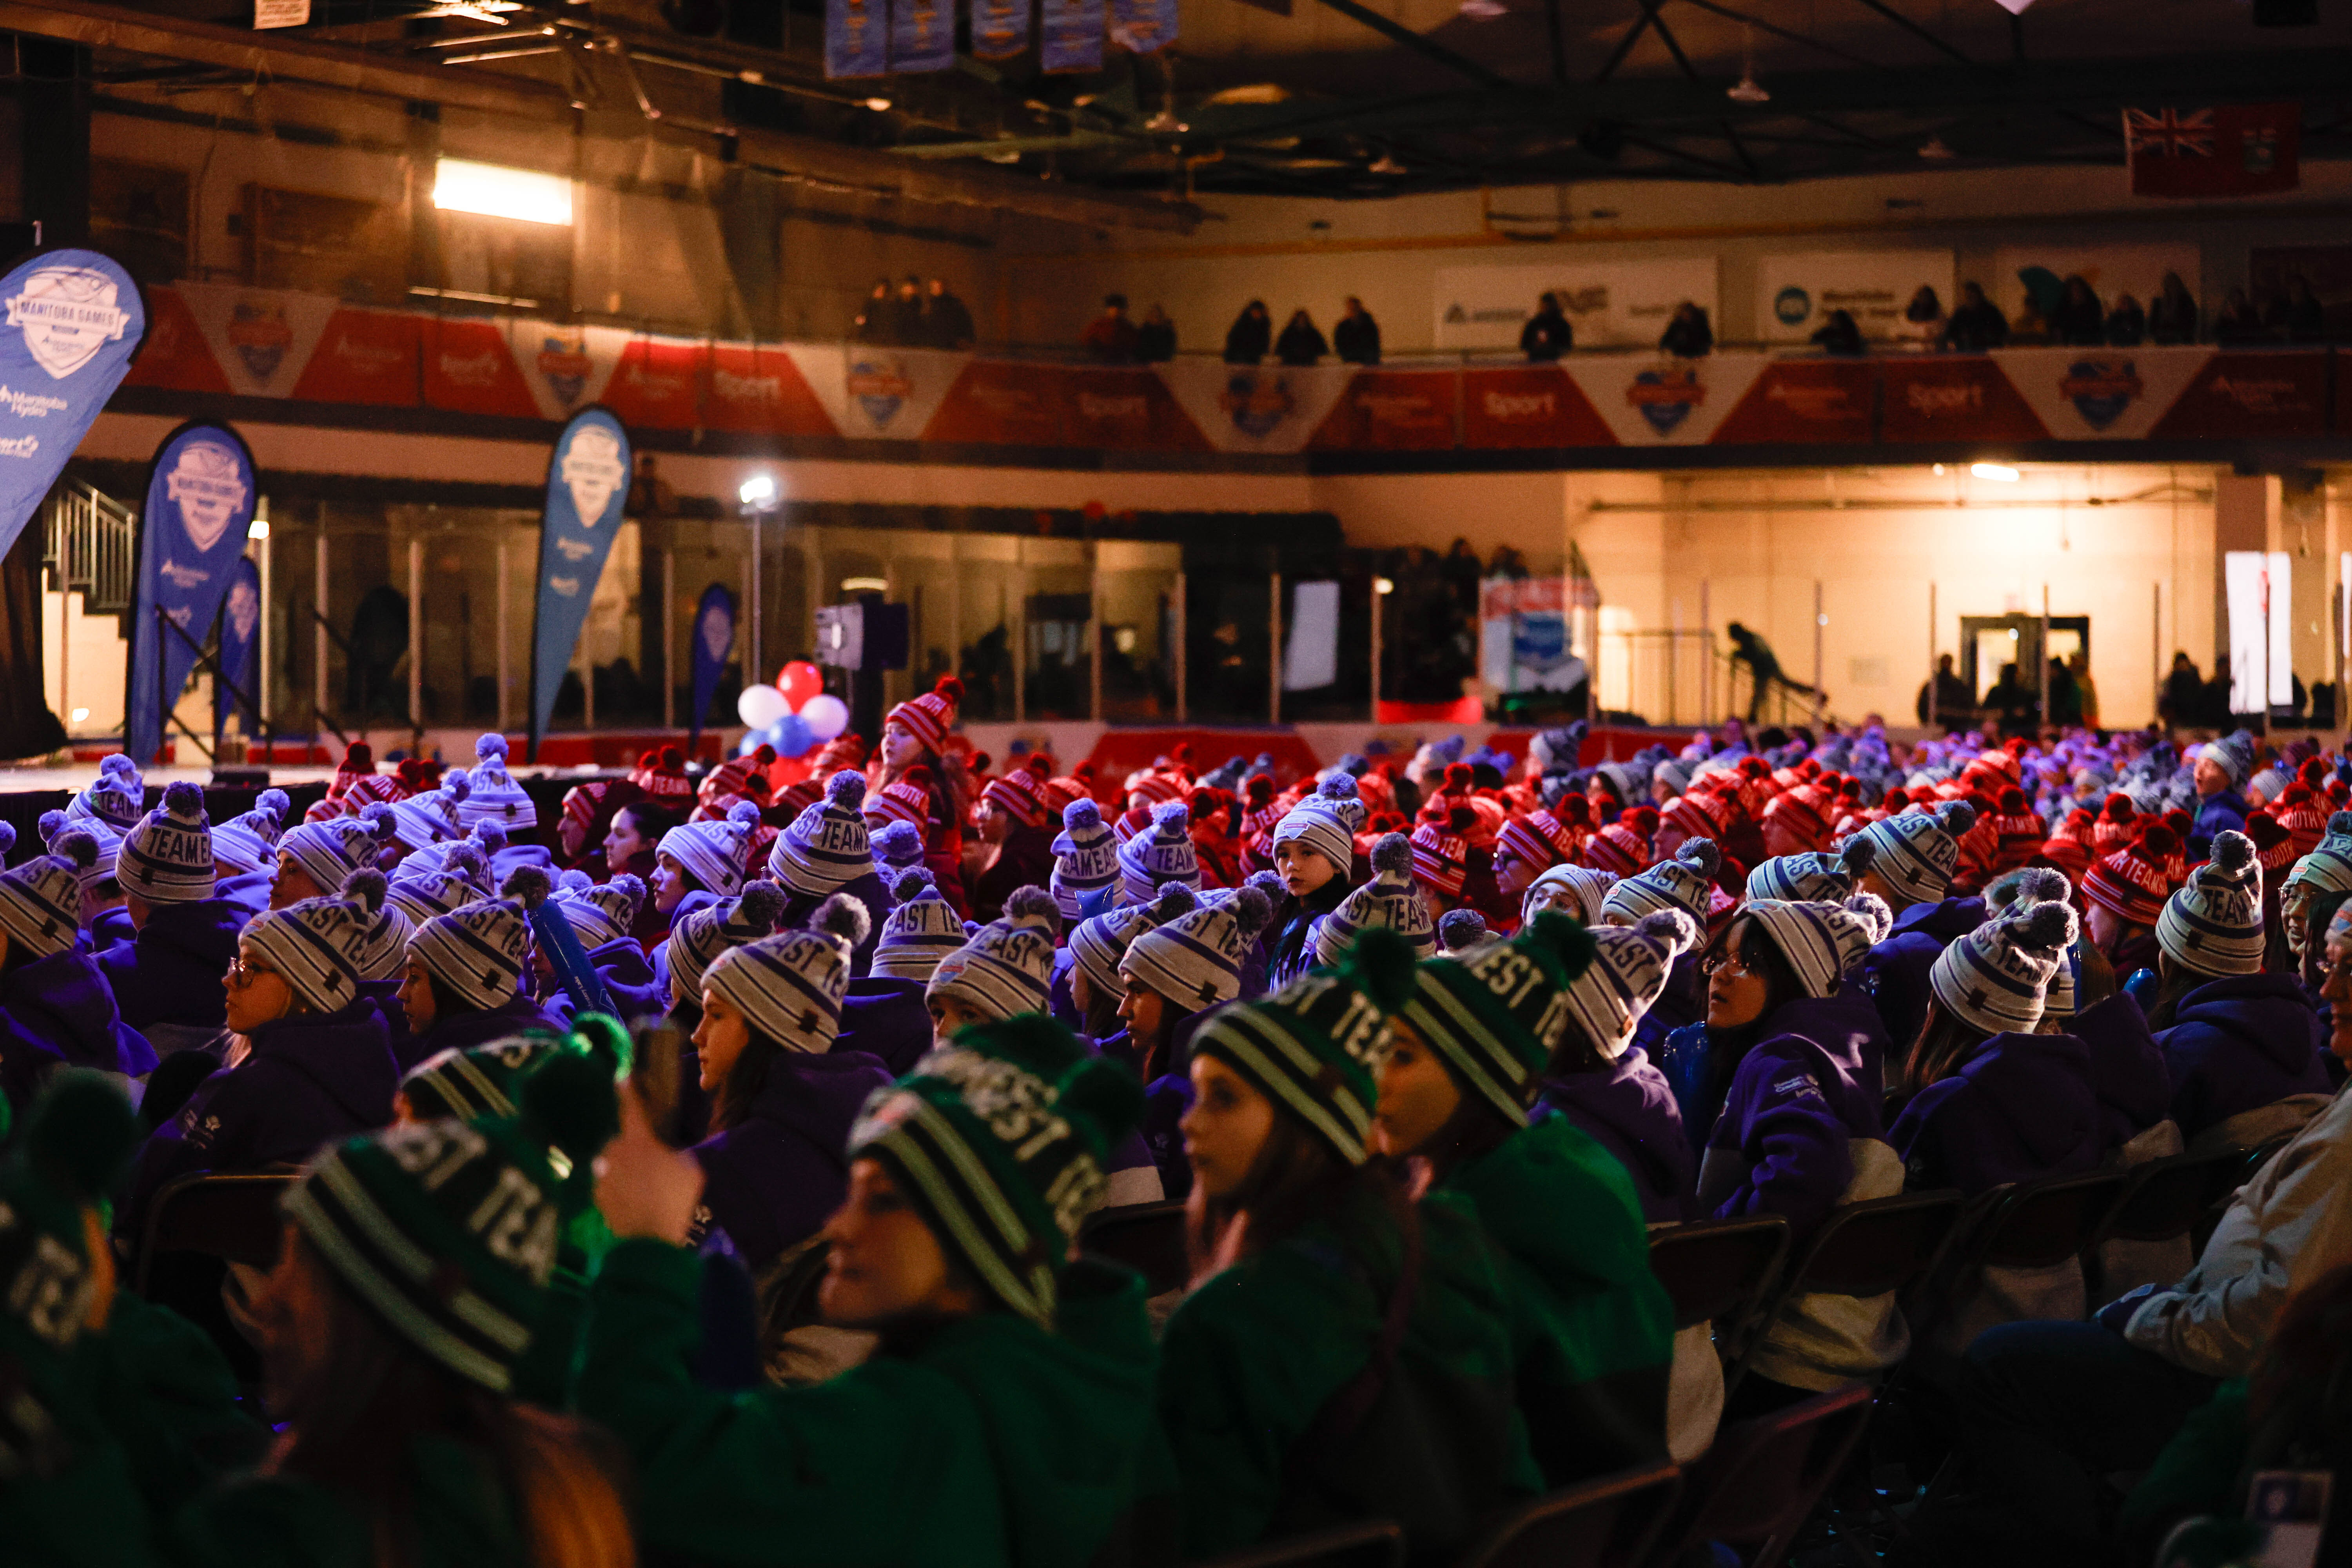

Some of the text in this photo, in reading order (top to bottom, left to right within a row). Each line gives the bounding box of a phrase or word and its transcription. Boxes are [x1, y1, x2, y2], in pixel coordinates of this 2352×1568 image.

[20, 301, 115, 326] MANITOBA GAMES
[472, 770, 493, 791] AST
[325, 820, 378, 867] AST TE
[696, 822, 733, 845] AST
[794, 811, 863, 852] AST TEAM
[1890, 813, 1933, 840] AST
[148, 826, 196, 864] TEAM
[408, 872, 456, 898] AST
[1641, 862, 1689, 892] AST
[1788, 852, 1819, 884] AST
[577, 885, 615, 907] AST
[1336, 890, 1431, 931] AST TEAM
[2202, 888, 2251, 926] TEAM
[297, 902, 349, 937] AST
[452, 906, 506, 937] AST
[1176, 907, 1219, 938] AST
[1813, 905, 1865, 941] AST
[987, 932, 1041, 967] AST
[1599, 935, 1656, 979] AST
[771, 938, 844, 998] AST TE
[1469, 946, 1544, 1009] EST
